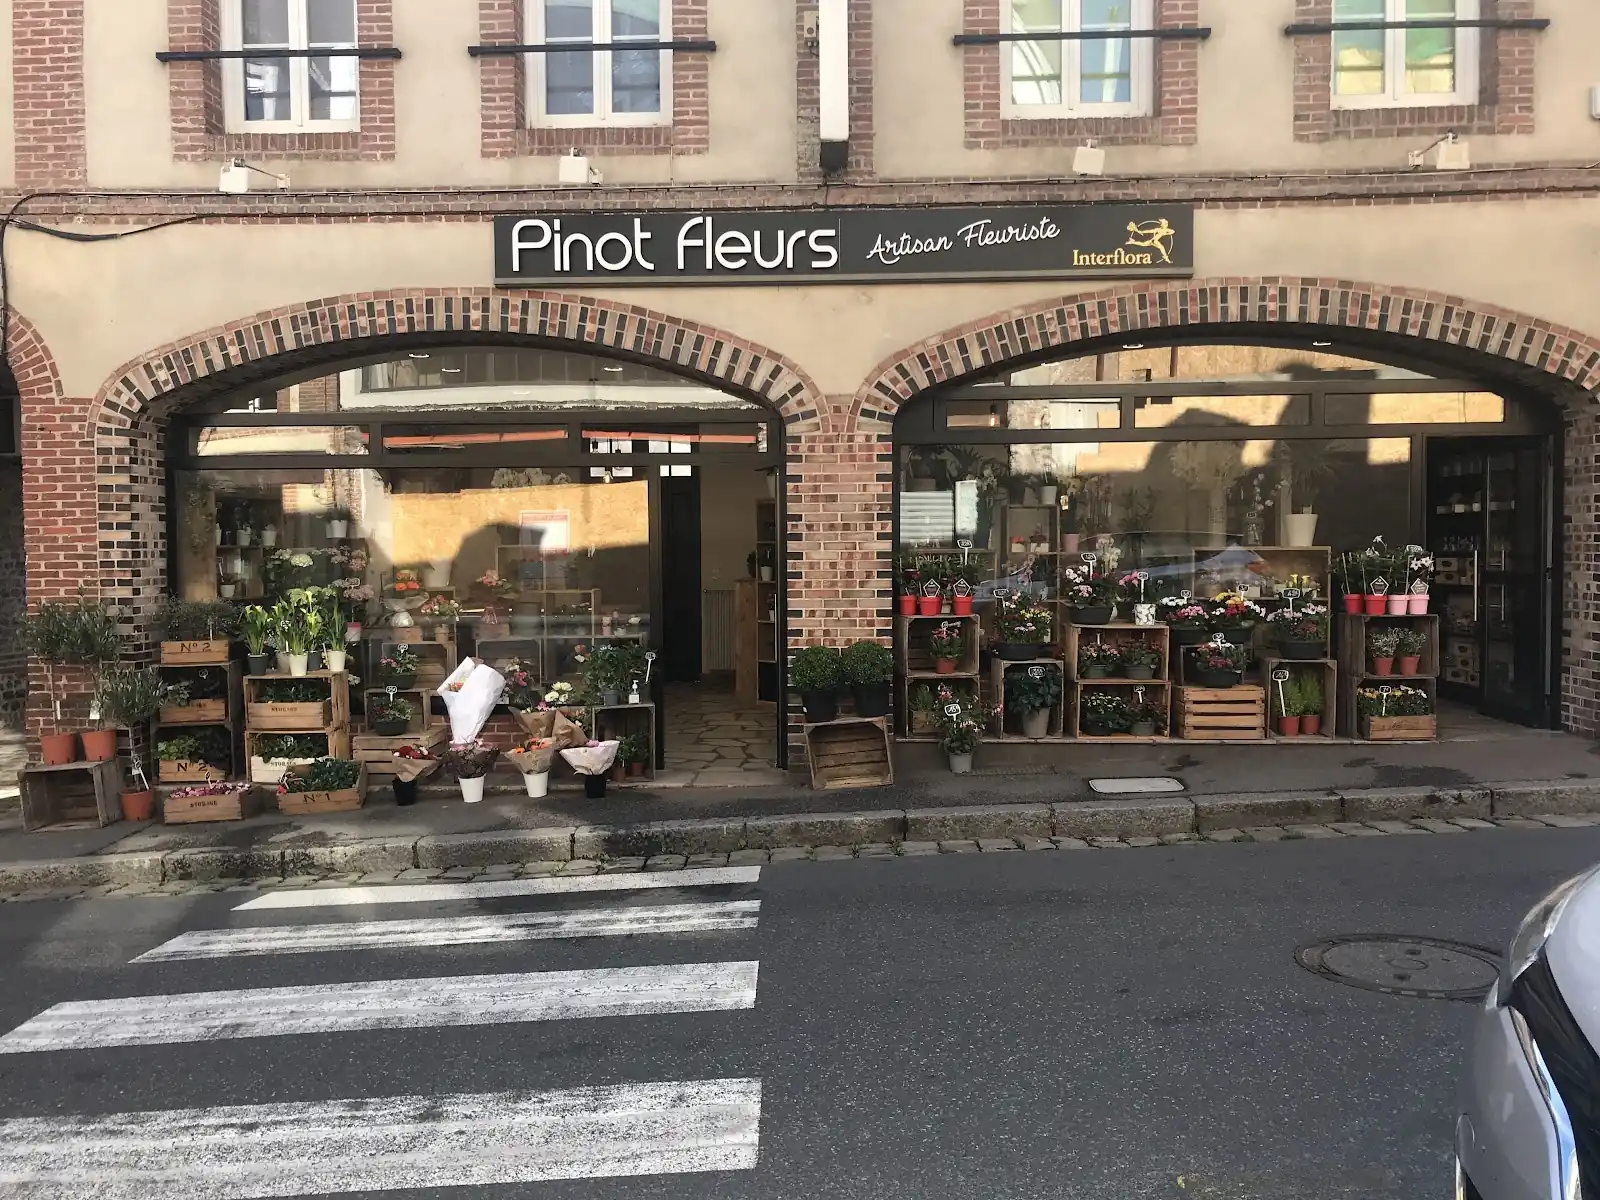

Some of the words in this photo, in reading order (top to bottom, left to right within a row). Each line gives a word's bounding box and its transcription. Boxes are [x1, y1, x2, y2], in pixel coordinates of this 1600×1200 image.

[511, 217, 655, 272] Pinot
[866, 231, 953, 265] Artisan
[957, 216, 1061, 249] Fleuriste
[1072, 248, 1153, 266] Interflora
